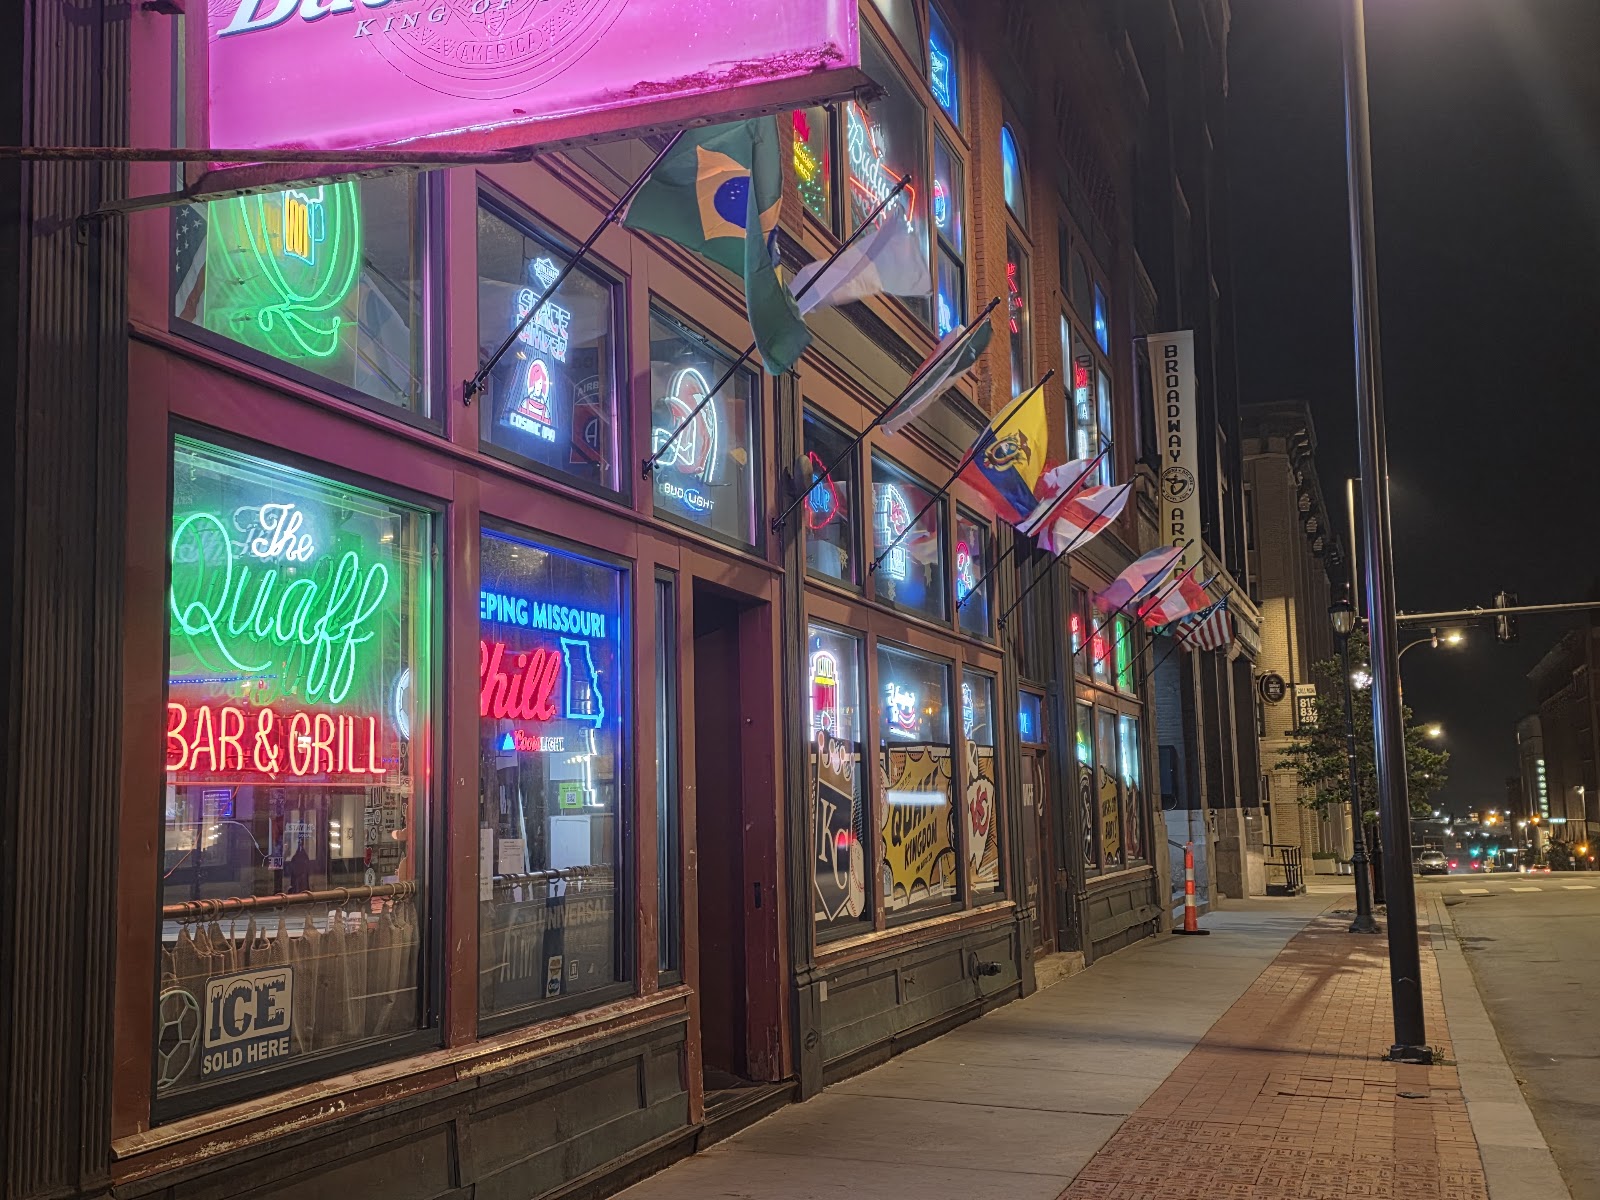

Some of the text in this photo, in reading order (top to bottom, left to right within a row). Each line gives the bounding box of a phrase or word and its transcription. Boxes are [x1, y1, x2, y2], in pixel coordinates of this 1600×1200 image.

[353, 7, 447, 38] KING
[459, 34, 537, 61] AMERICA
[1164, 344, 1182, 463] BROADWAY
[510, 411, 541, 438] COSMIC
[664, 482, 684, 500] BUD
[252, 502, 315, 562] The
[170, 512, 390, 704] Quaff
[532, 601, 606, 638] MISSOURI
[166, 702, 245, 773] BAR
[289, 711, 387, 776] GRILL
[540, 735, 565, 752] LIGHT
[209, 972, 288, 1042] ICE
[202, 1037, 290, 1076] SOLD HERE
